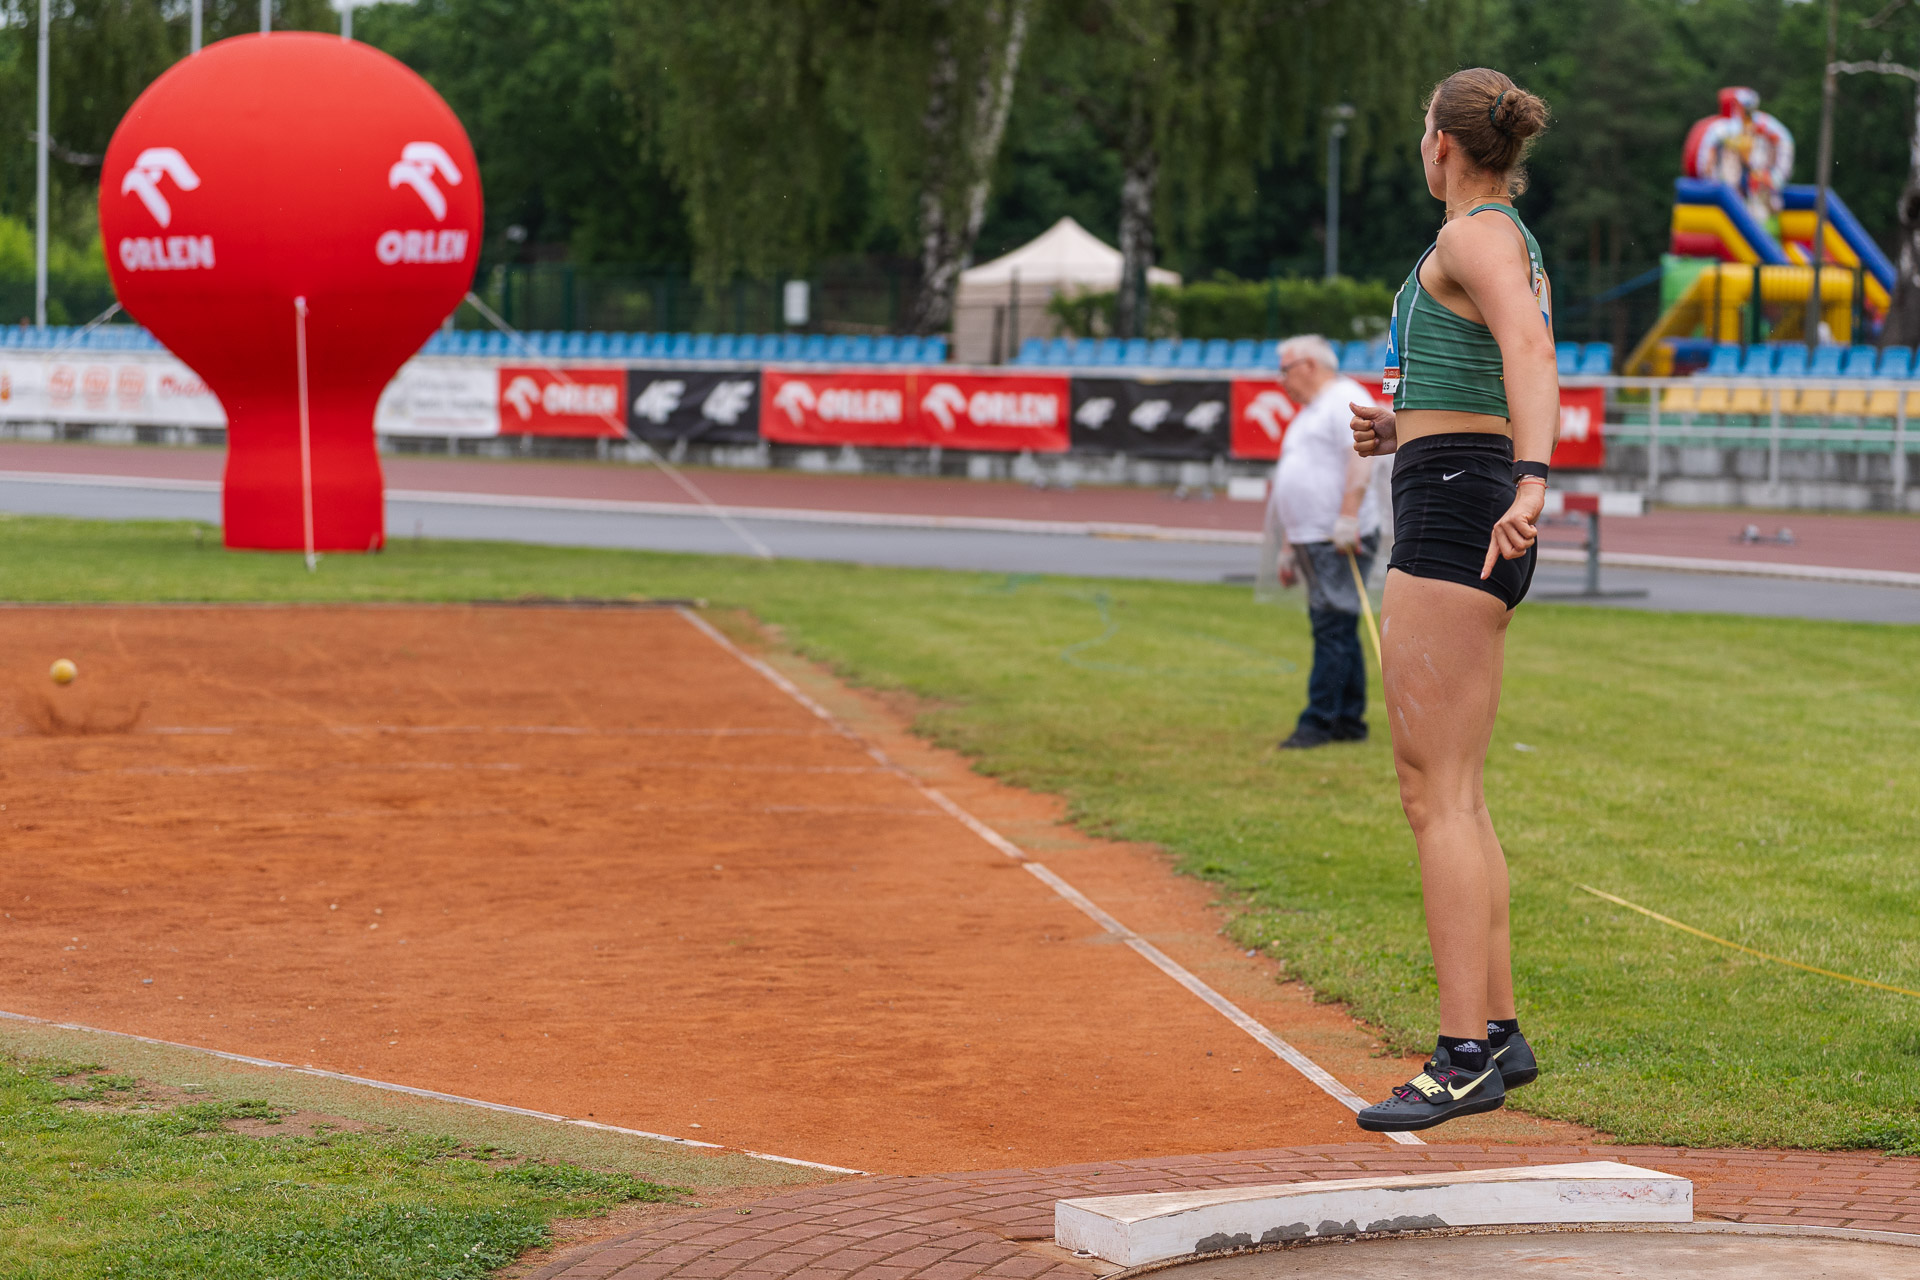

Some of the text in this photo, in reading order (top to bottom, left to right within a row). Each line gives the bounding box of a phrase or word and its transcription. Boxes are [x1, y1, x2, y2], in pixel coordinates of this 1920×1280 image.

[119, 235, 215, 271] ORLEN
[377, 230, 468, 265] ORLEN
[544, 382, 618, 415] ORLEN
[817, 388, 902, 422] ORLEN
[968, 391, 1059, 428] ORLEN
[1409, 1072, 1446, 1098] NIKE
